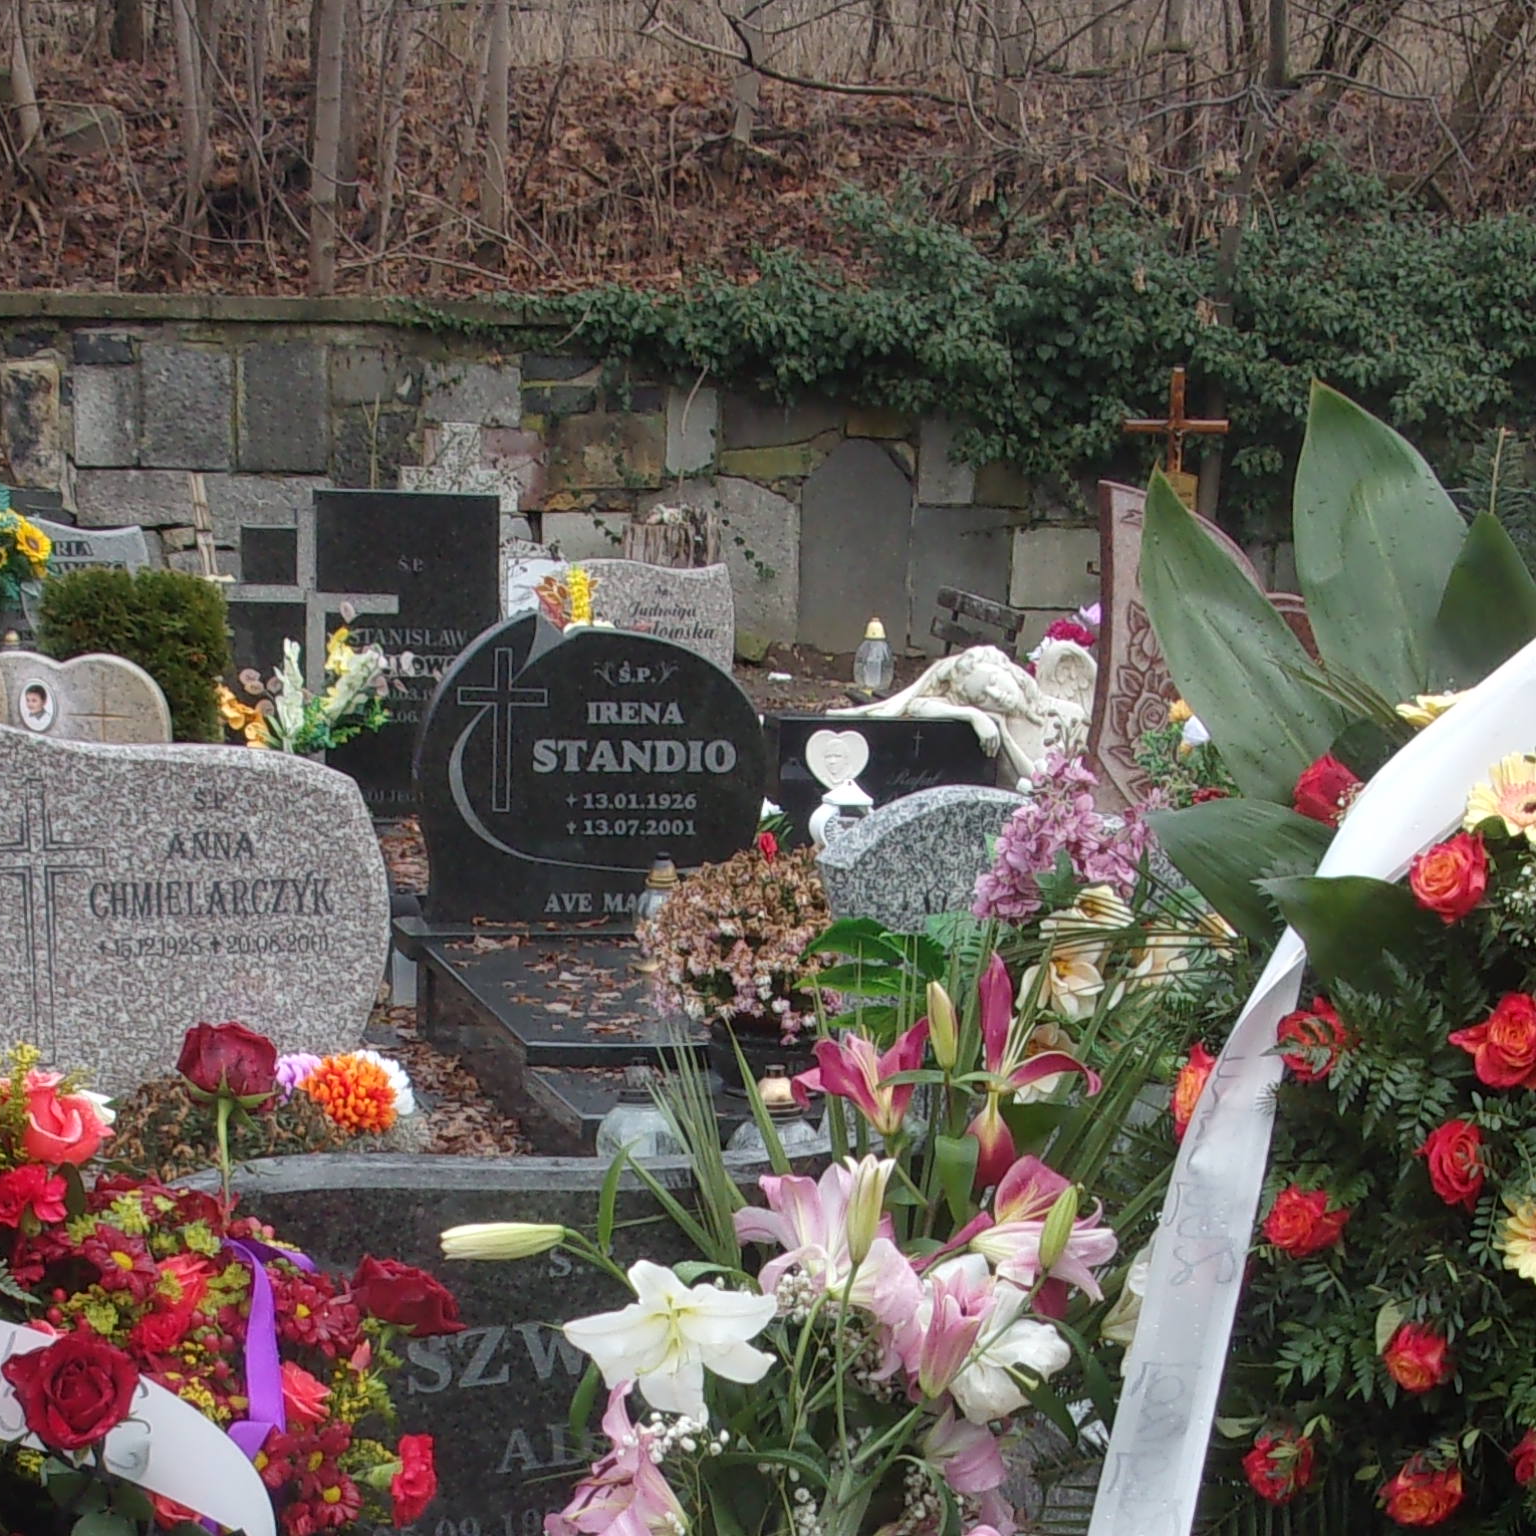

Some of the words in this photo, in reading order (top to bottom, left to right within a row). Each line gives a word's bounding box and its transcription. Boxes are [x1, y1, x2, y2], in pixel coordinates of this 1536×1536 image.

[586, 701, 684, 725] IRENA
[532, 738, 737, 774] STANDIO
[583, 792, 697, 811] 13.01.1926
[583, 818, 697, 836] 13.07.2001
[164, 831, 256, 861] ANNA
[89, 872, 335, 921] CHMIELARCZYK
[543, 892, 593, 914] AVE
